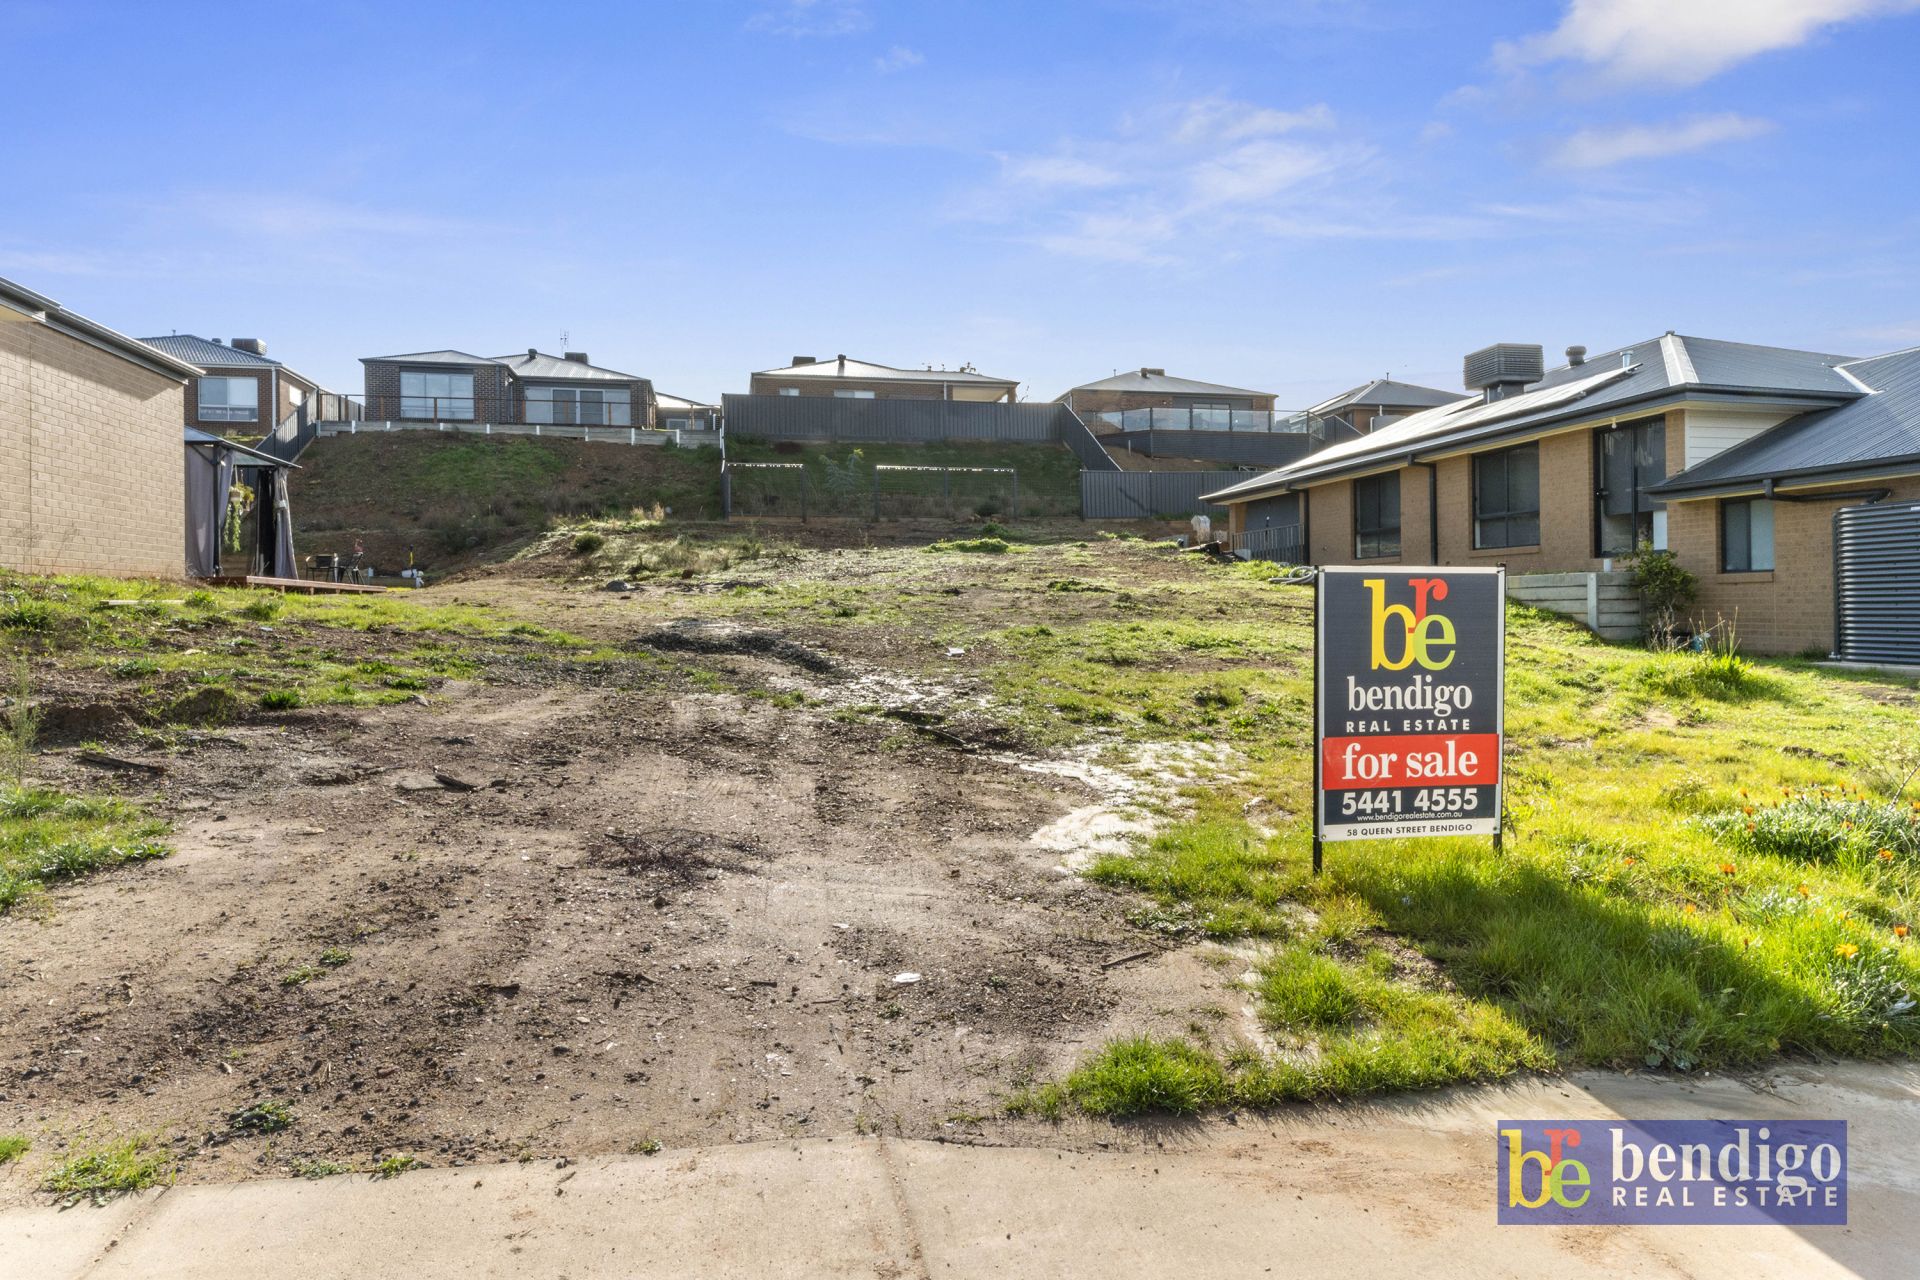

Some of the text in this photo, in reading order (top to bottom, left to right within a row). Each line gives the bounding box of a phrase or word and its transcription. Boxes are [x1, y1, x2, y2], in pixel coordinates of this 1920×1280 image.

[1347, 675, 1472, 717] bendigo
[1346, 719, 1471, 732] REAL ESTATE
[1342, 740, 1478, 780] for sale
[1342, 788, 1478, 815] 5441 4555
[1357, 812, 1463, 822] www.bendigorealestate.com.au
[1395, 826, 1427, 834] STREET
[1430, 824, 1472, 832] BENDIGO
